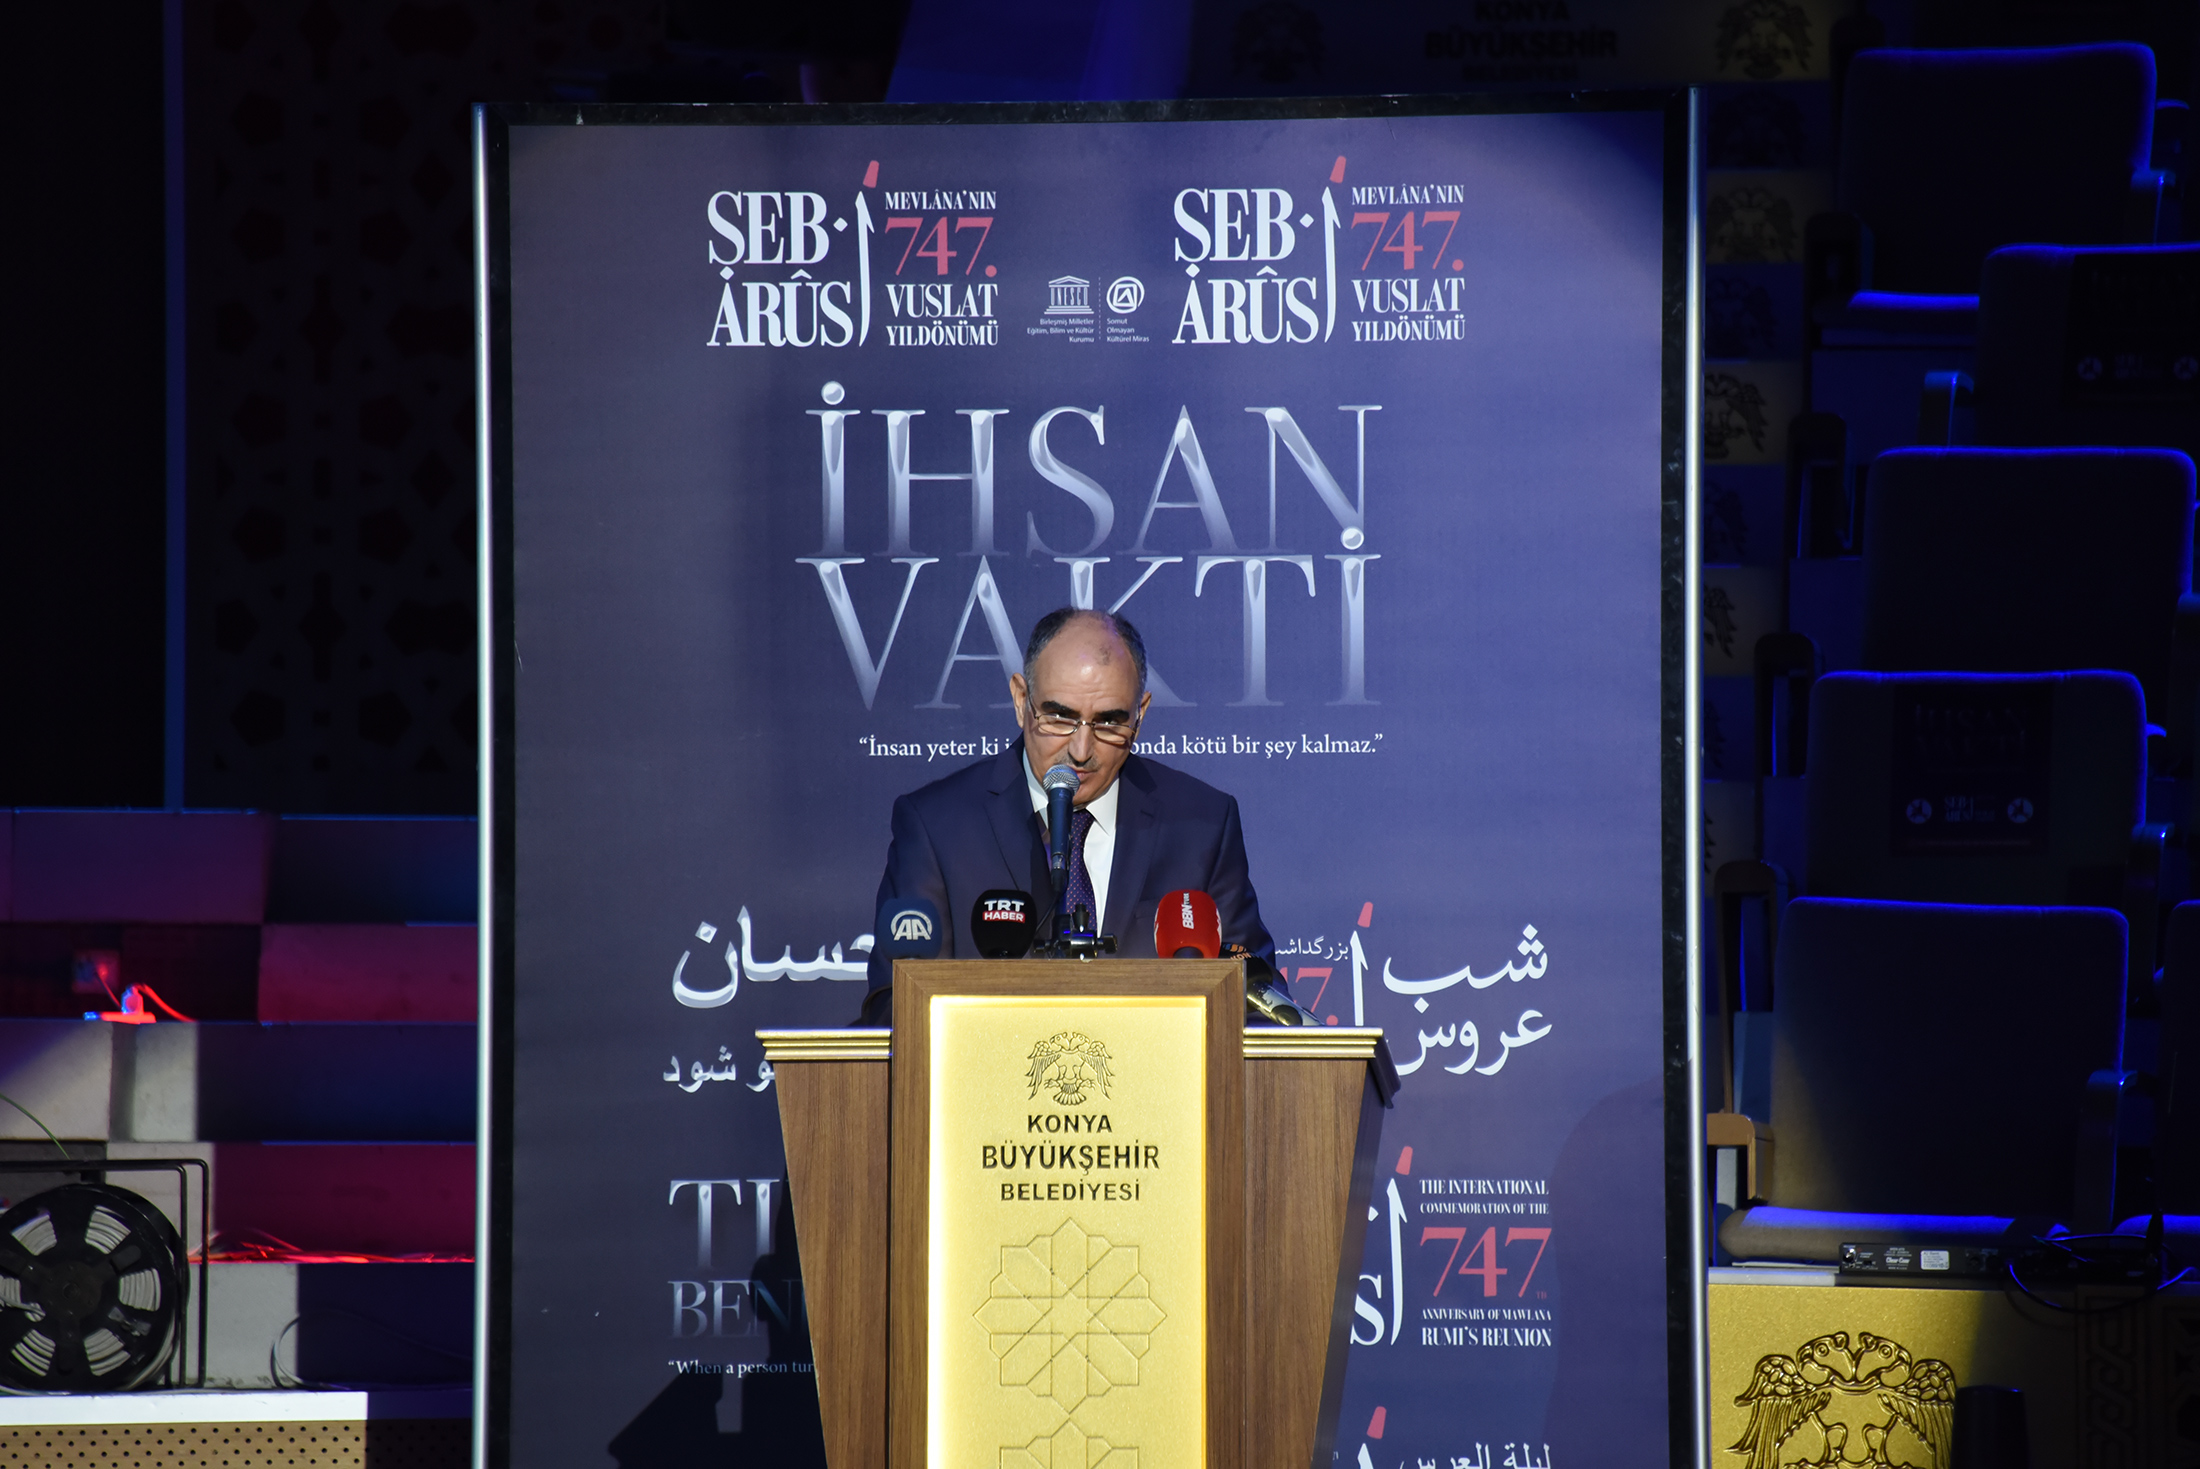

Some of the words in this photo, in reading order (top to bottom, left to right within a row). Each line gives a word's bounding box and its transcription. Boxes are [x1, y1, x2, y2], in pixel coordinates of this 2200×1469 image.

[884, 216, 997, 278] 747.
[1351, 210, 1465, 272] 747.
[885, 283, 998, 319] VUSLAT
[1352, 277, 1466, 314] VUSLAT
[885, 319, 999, 347] YILDÖNÜMÜ
[1039, 318, 1068, 326] Birleşmiş
[1106, 317, 1128, 325] Somut
[1106, 327, 1135, 335] Olmayan
[1352, 313, 1466, 343] YILDÖNÜMÜ
[1106, 335, 1132, 343] Kültürel
[1132, 335, 1150, 343] Miras
[805, 381, 1383, 558] İHSAN
[795, 526, 1383, 711] VAKTİ
[926, 740, 977, 763] yeter
[981, 735, 999, 756] ki
[1181, 734, 1227, 755] kötü
[1231, 735, 1261, 754] bir
[1264, 740, 1297, 760] şey
[984, 899, 1025, 912] TRT
[984, 911, 1024, 922] HABER
[893, 918, 931, 941] AA
[1383, 924, 1548, 1014] شب
[1394, 1009, 1553, 1076] عروس
[662, 1045, 737, 1094] شود
[1027, 1114, 1113, 1134] KONYA
[982, 1139, 1160, 1176] BÜYÜKŞEHİR
[1001, 1178, 1140, 1201] BELEDİYESİ
[1419, 1179, 1446, 1195] THE
[1449, 1179, 1549, 1195] INTERNATIONAL
[1420, 1202, 1511, 1214] COMMEMORATION
[1513, 1203, 1525, 1214] OF
[1529, 1203, 1549, 1215] THE
[1420, 1227, 1552, 1298] 747
[1421, 1308, 1485, 1321] ANNIVERSARY
[1488, 1308, 1500, 1320] OF
[1502, 1308, 1552, 1321] MAWLANA
[1482, 1327, 1552, 1347] REUNION
[725, 1364, 734, 1374] a
[737, 1363, 788, 1379] person
